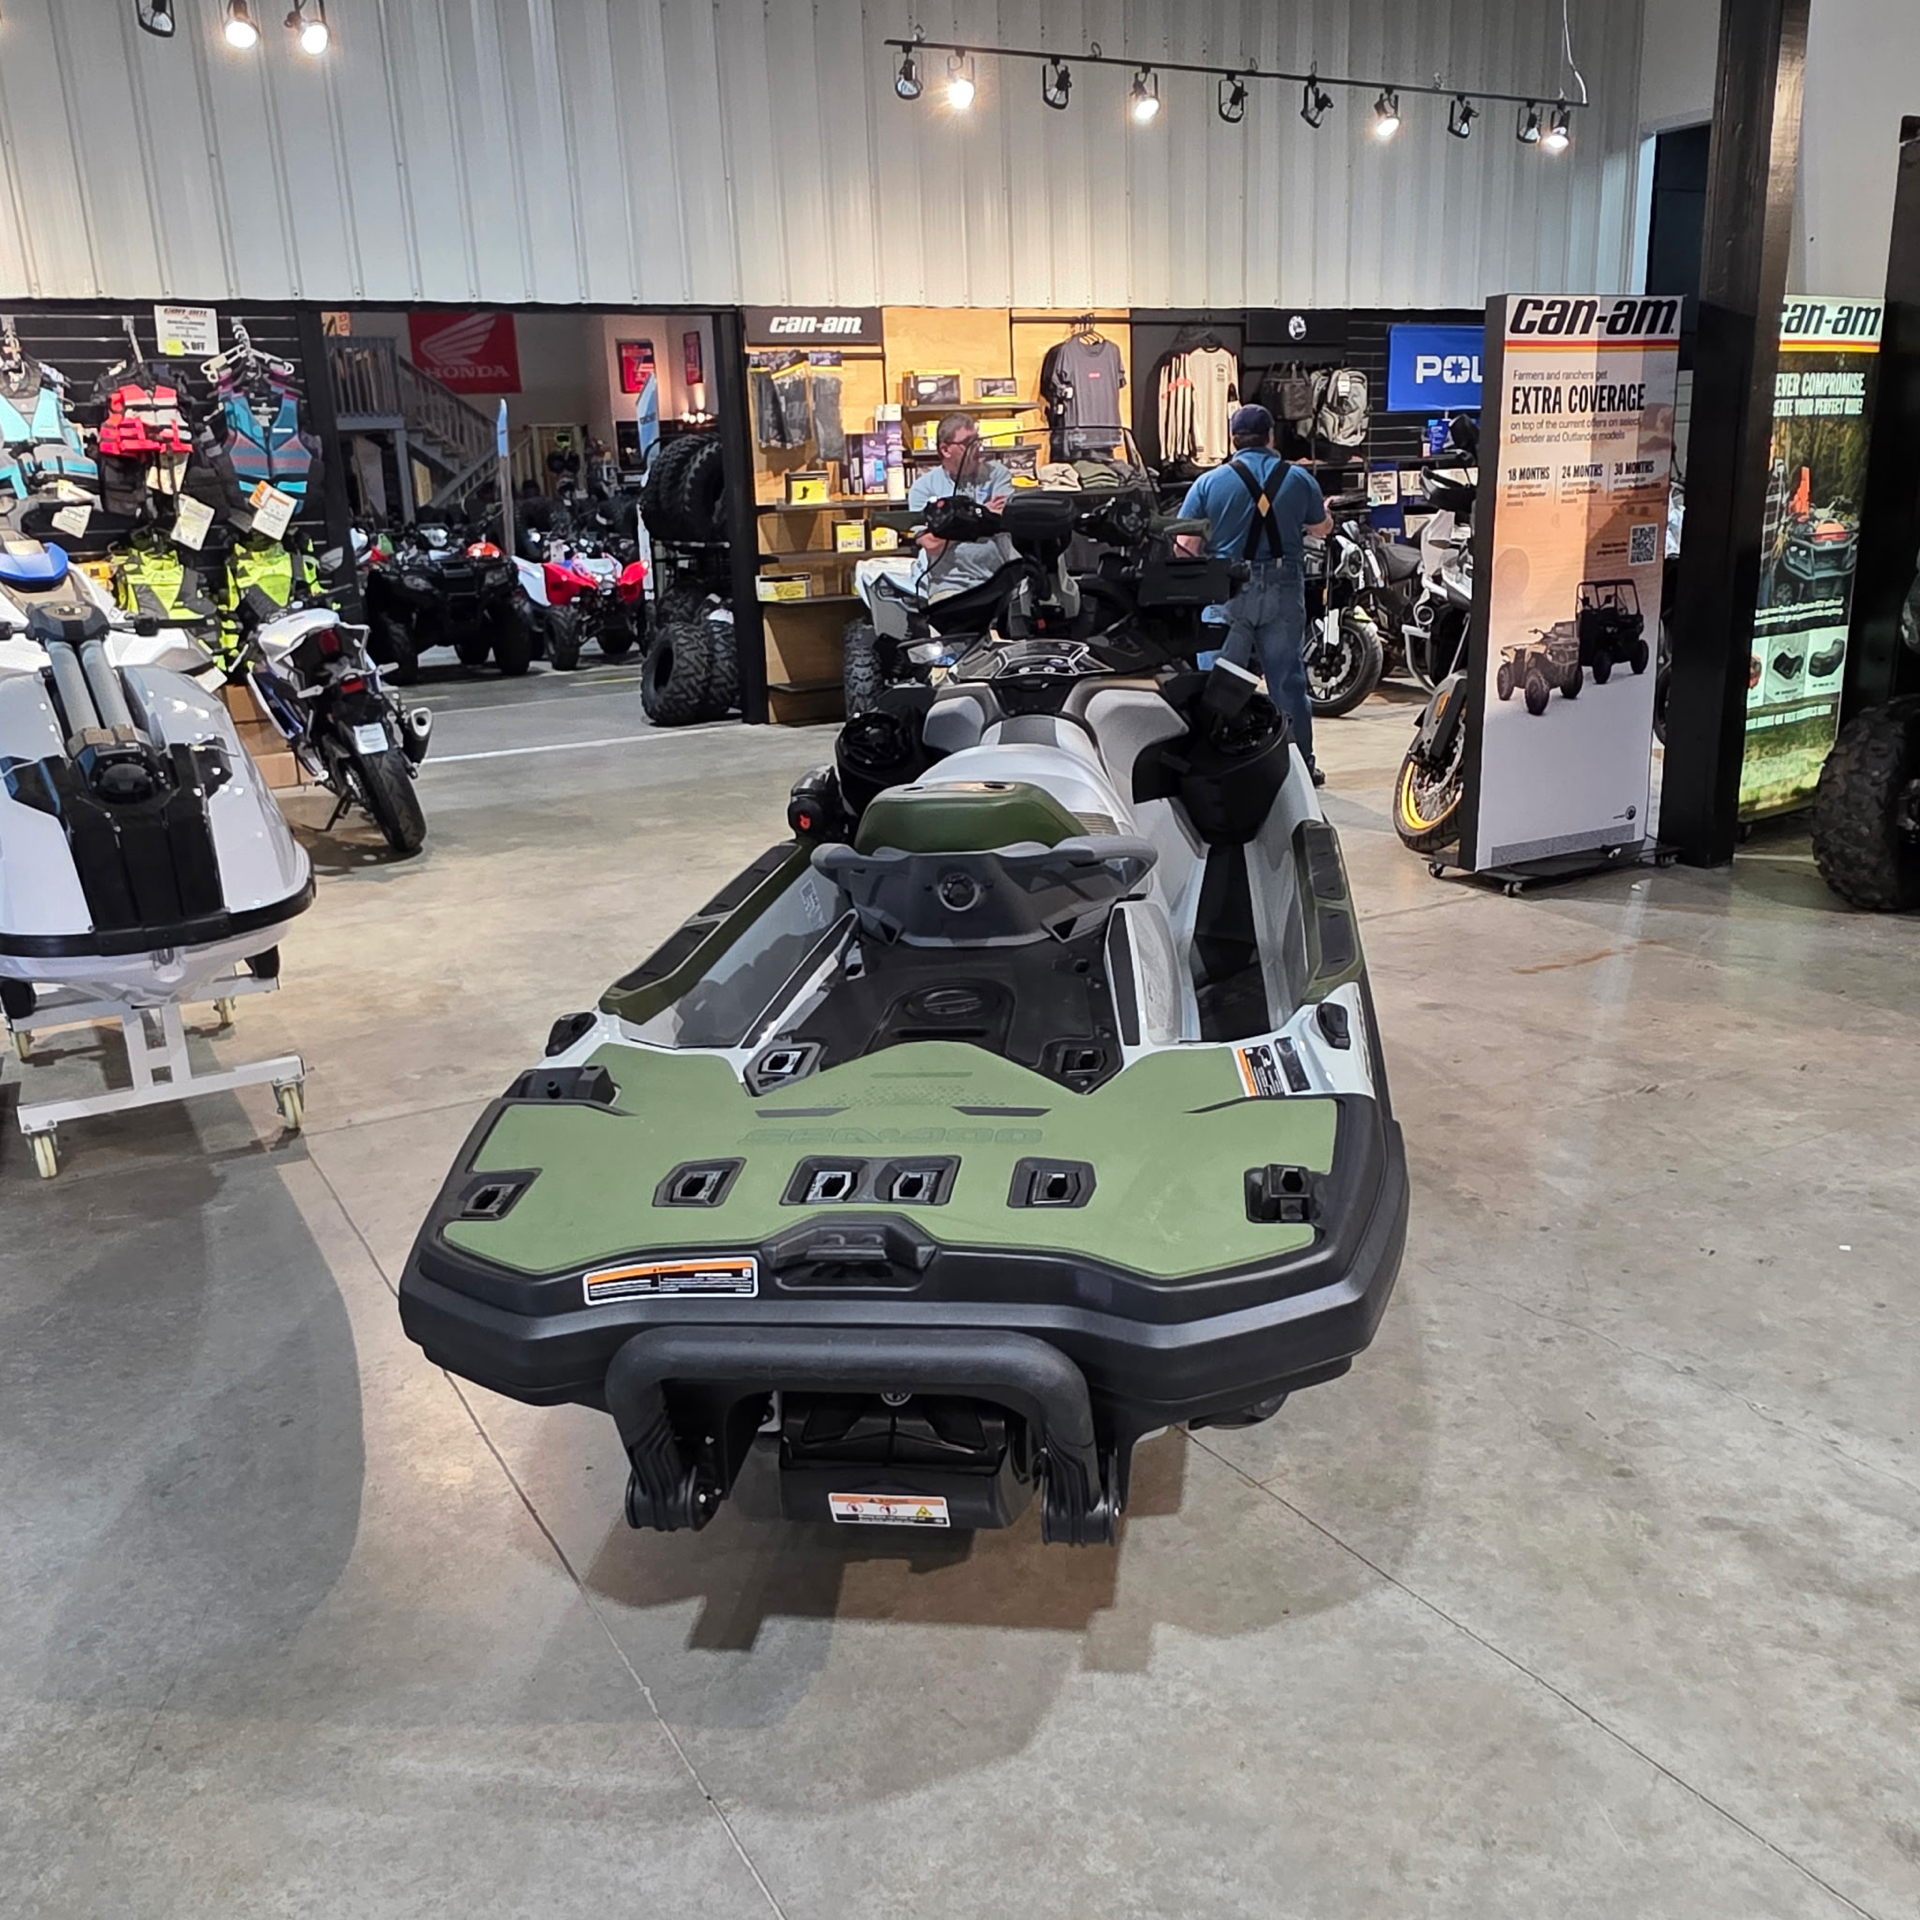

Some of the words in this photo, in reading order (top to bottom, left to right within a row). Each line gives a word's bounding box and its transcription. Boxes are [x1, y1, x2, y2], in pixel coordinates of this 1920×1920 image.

[1510, 299, 1678, 335] can-am
[424, 365, 510, 378] HONDA
[1514, 370, 1544, 380] Farmers
[1546, 370, 1560, 380] and
[1562, 370, 1594, 380] ranchers
[1596, 370, 1608, 382] get
[1512, 386, 1562, 414] EXTRA
[1568, 383, 1646, 413] COVERAGE
[1510, 421, 1520, 430] on
[1522, 420, 1534, 431] top
[1536, 419, 1544, 429] of
[1546, 419, 1558, 429] the
[1559, 419, 1586, 429] current
[1586, 418, 1607, 427] offers
[1609, 419, 1618, 427] on
[1620, 417, 1642, 426] select
[1510, 432, 1545, 444] Defender
[1546, 432, 1560, 443] and
[1562, 431, 1598, 442] Outlander
[1600, 430, 1625, 440] models
[1508, 469, 1517, 481] 18
[1519, 467, 1550, 480] MONTHS
[1562, 466, 1571, 479] 24
[1573, 464, 1603, 478] MONTHS
[1614, 463, 1623, 475] 30
[1625, 461, 1654, 475] MONTHS
